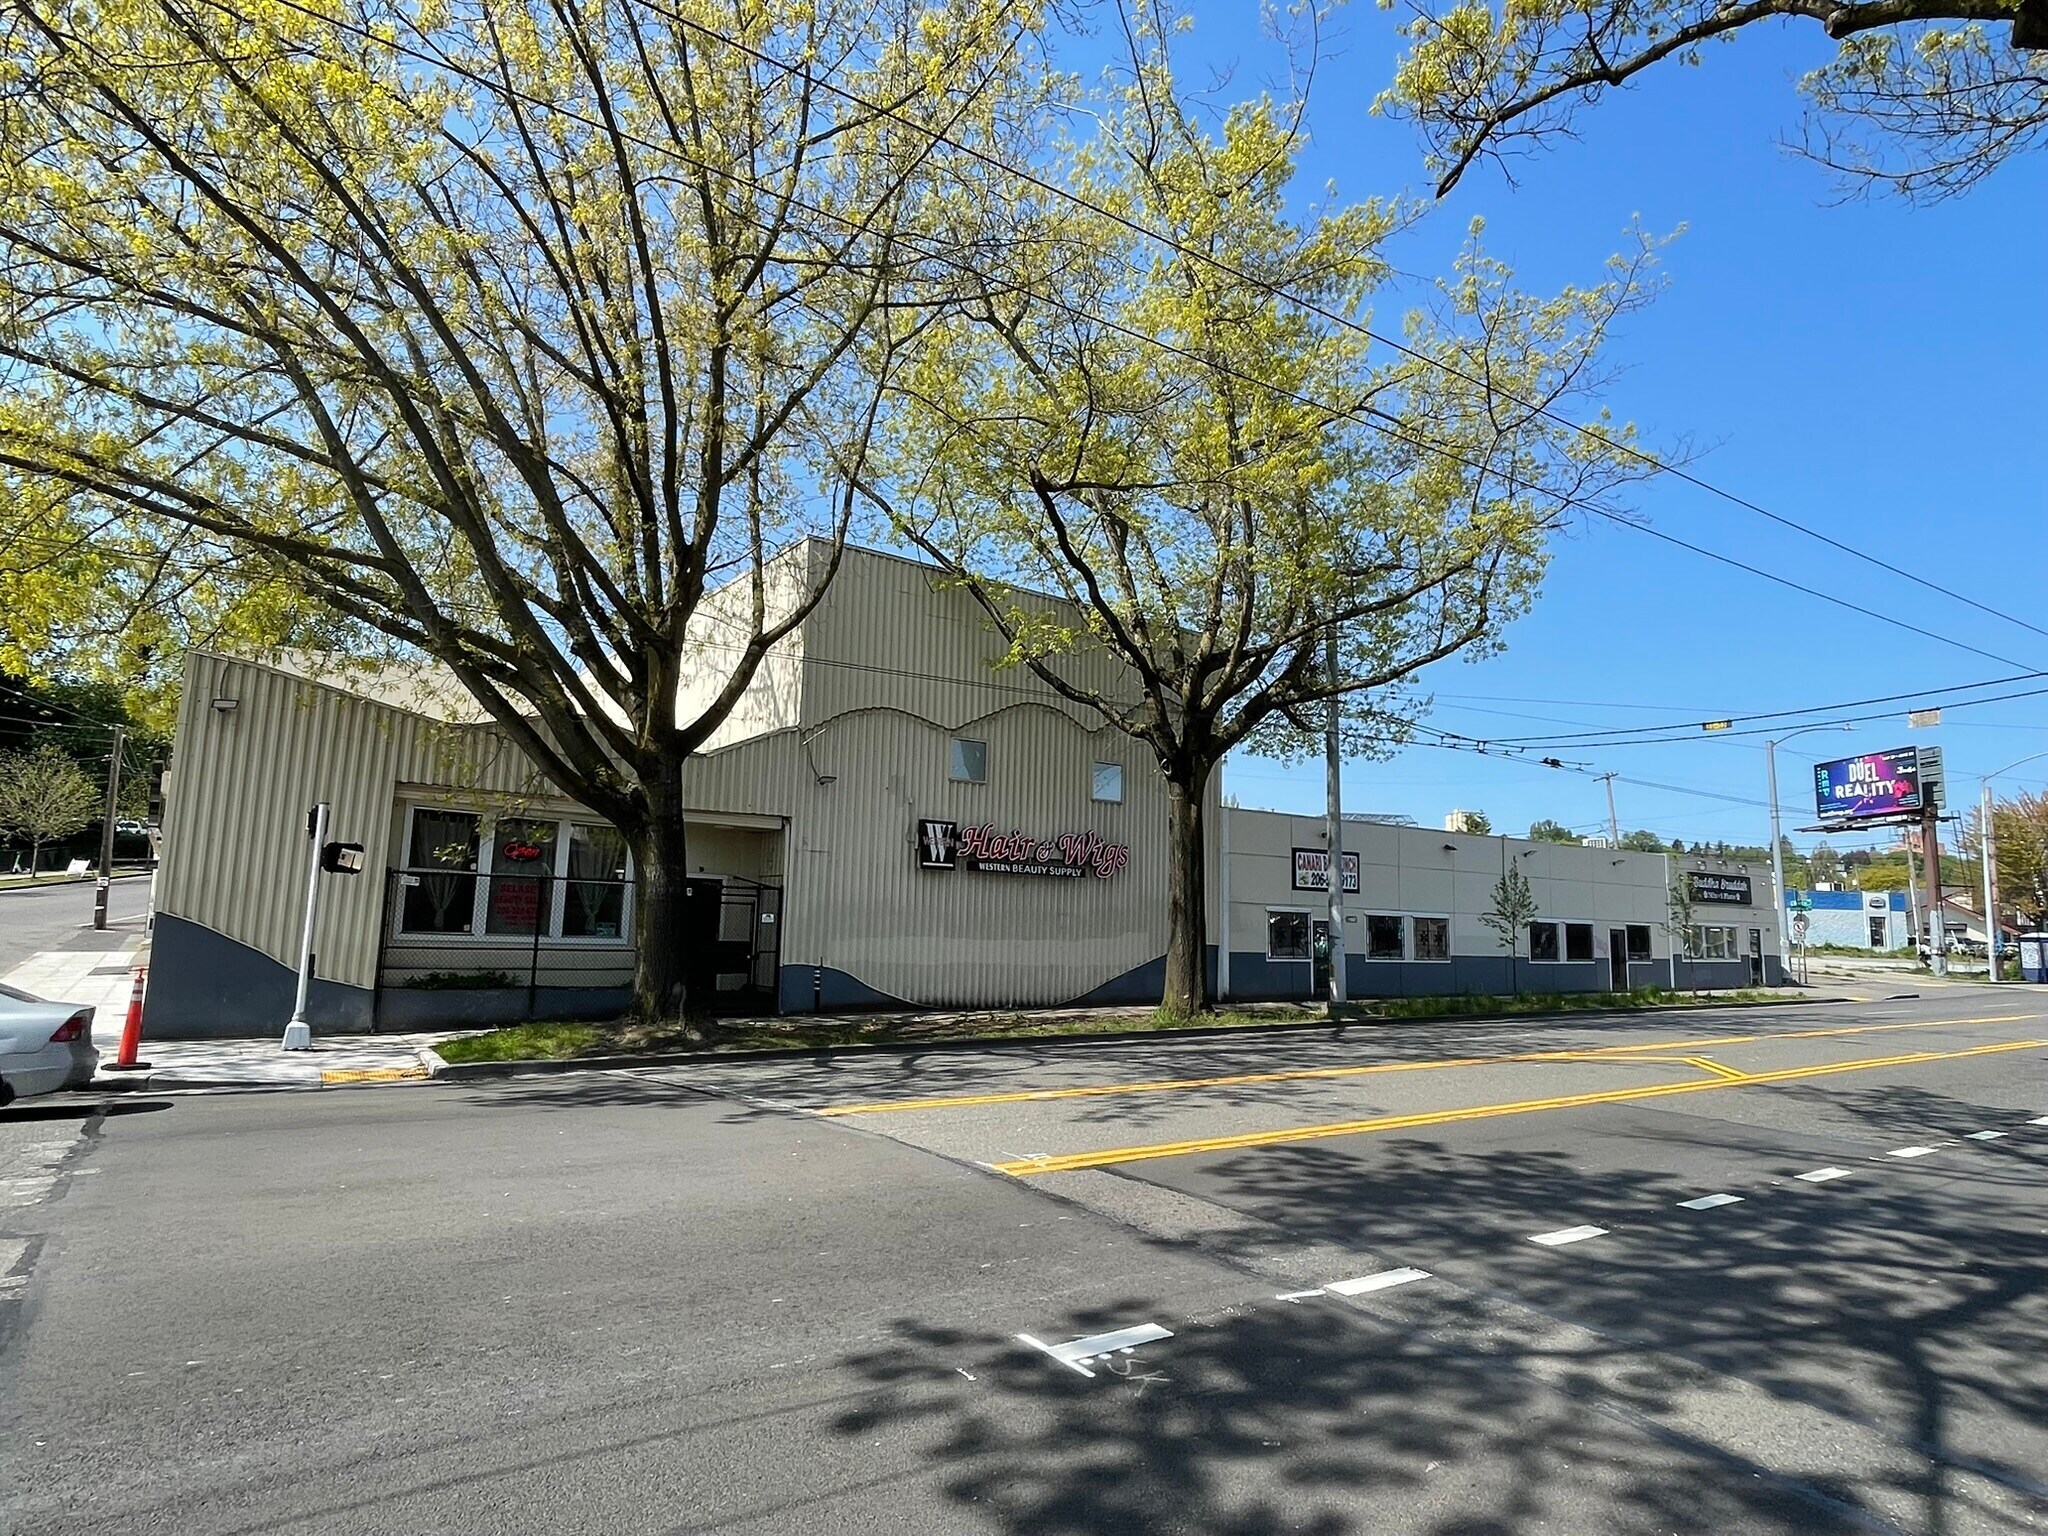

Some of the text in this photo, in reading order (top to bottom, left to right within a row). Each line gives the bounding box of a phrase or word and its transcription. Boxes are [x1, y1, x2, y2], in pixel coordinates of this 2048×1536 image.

[1848, 760, 1880, 783] DUEL
[957, 823, 1035, 861] Hair
[1058, 830, 1129, 878] Wigs
[979, 861, 1082, 877] WESTERN BEAUTY SUPPLY
